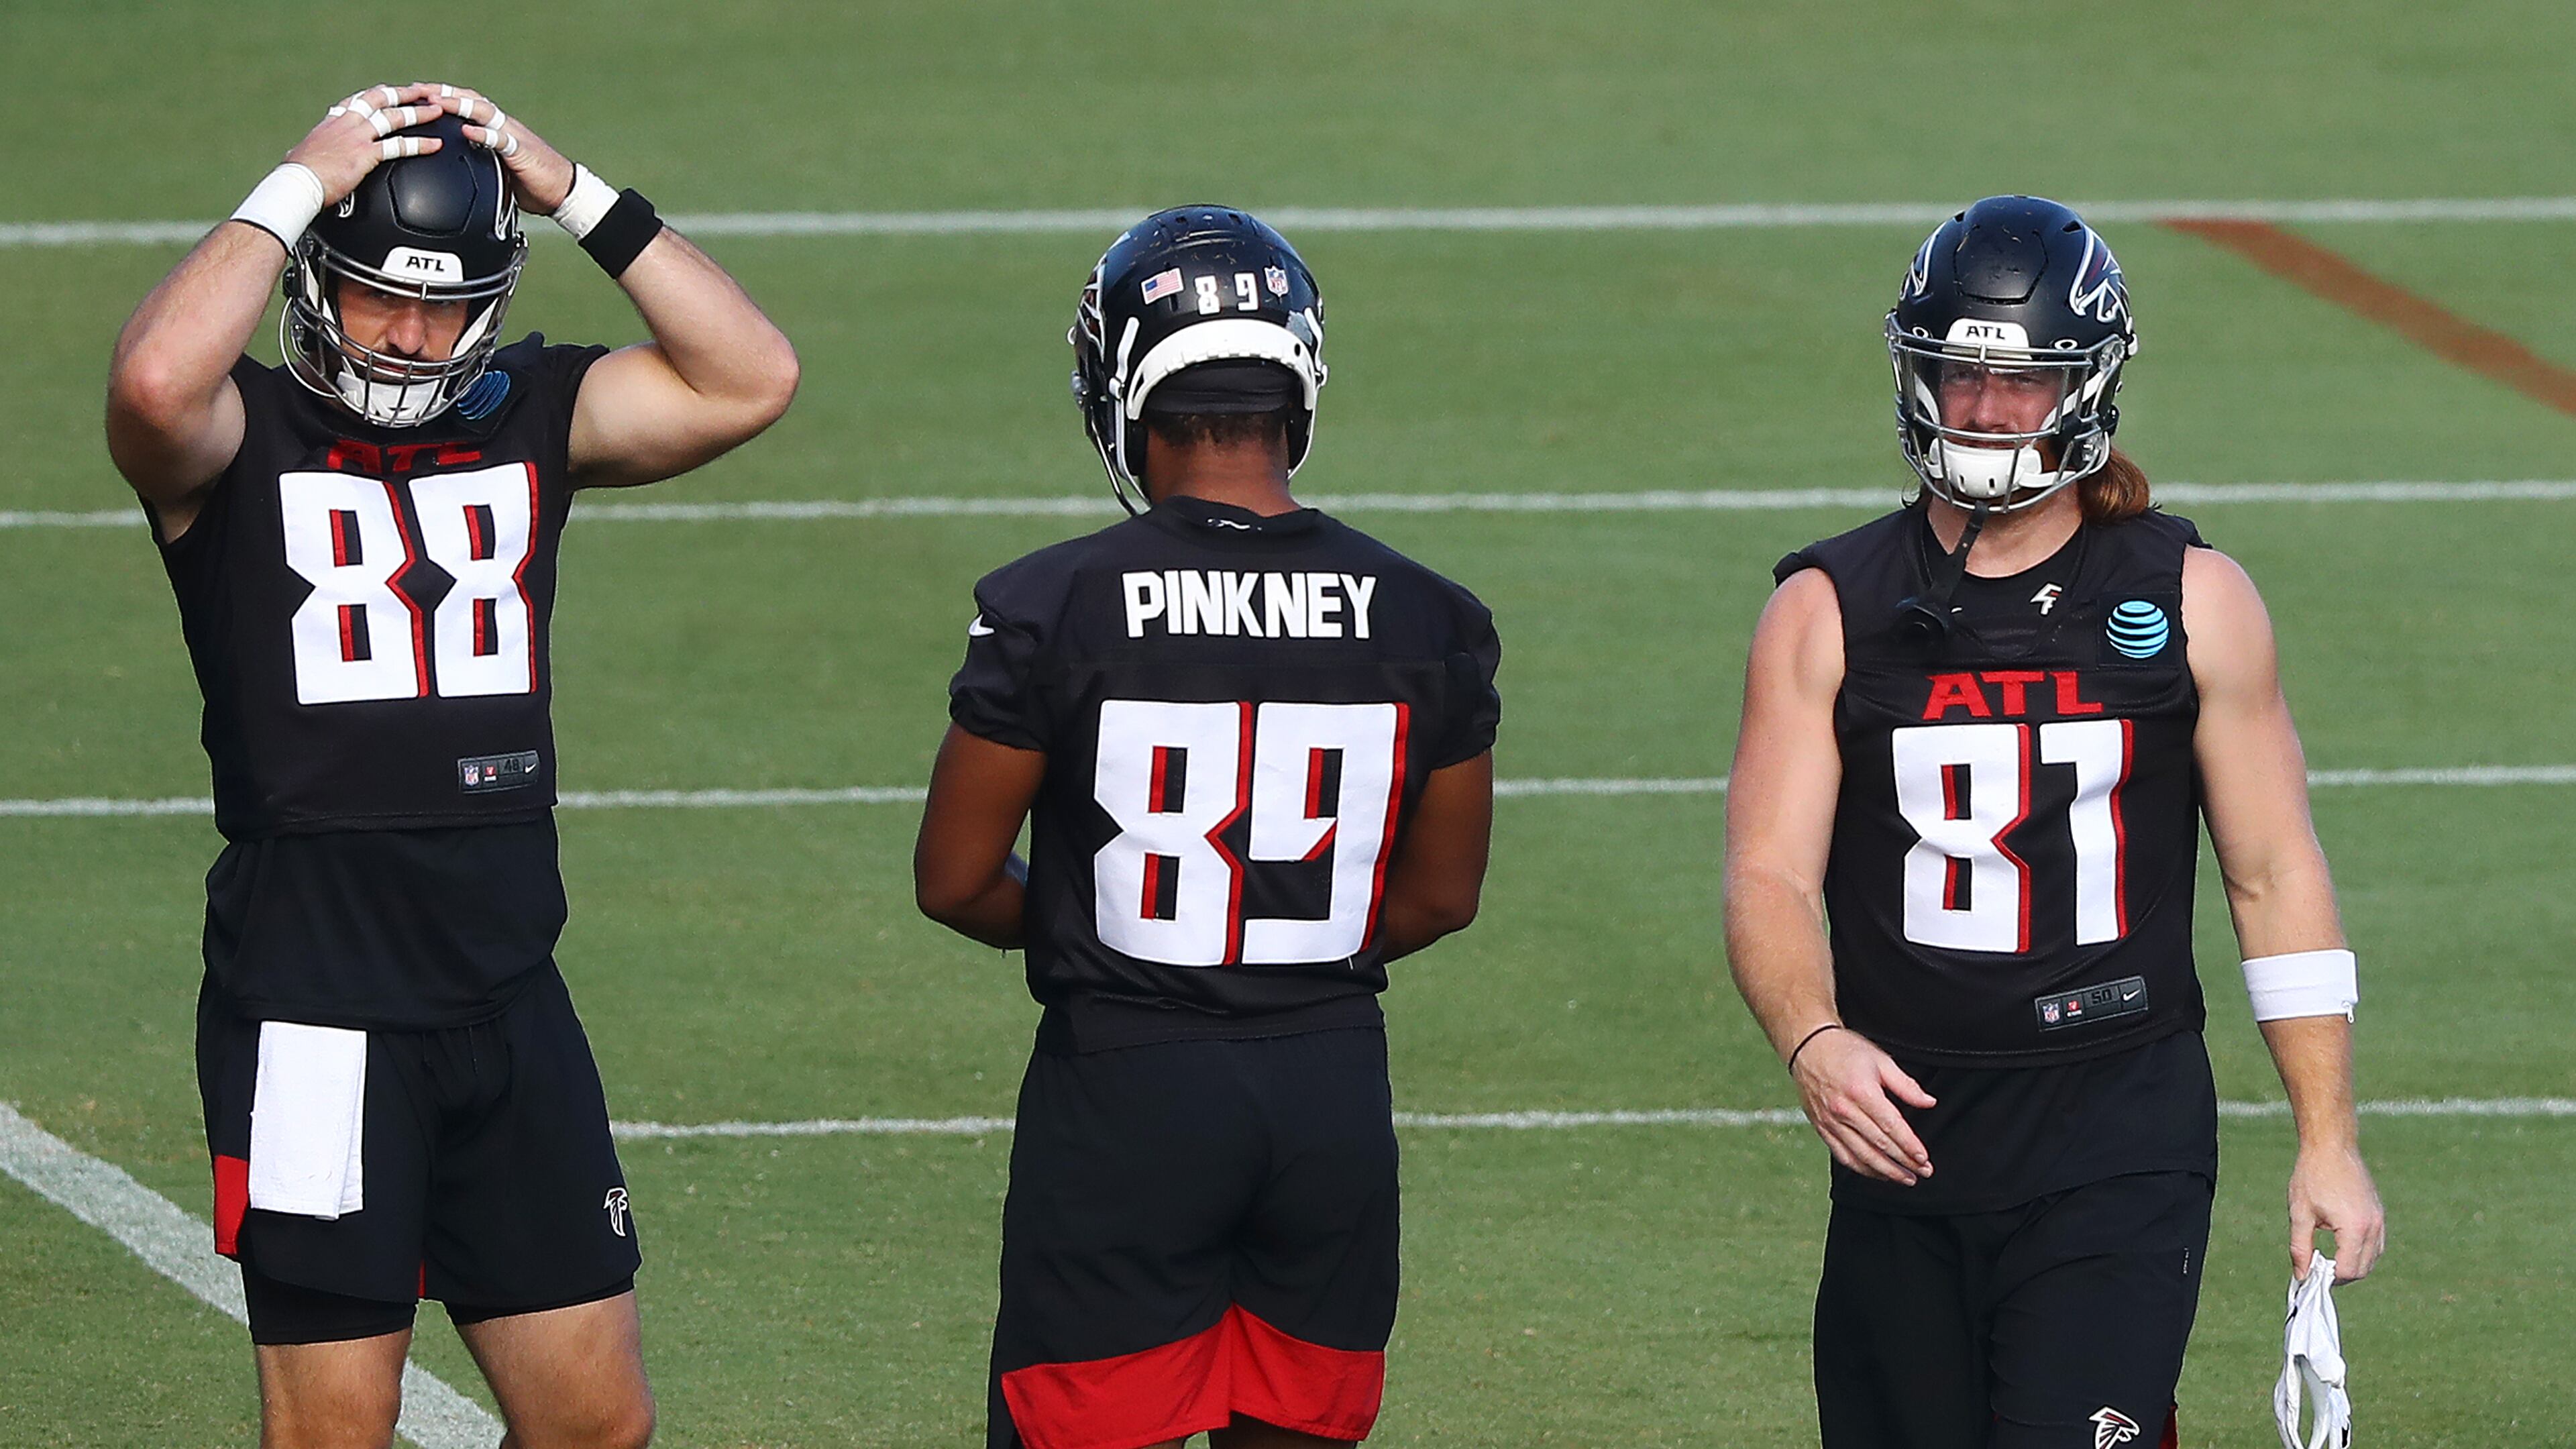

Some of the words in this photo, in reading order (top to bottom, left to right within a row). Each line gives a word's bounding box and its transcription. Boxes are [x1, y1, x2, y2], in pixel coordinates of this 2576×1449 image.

[405, 256, 445, 272] ATL
[1966, 325, 2005, 340] ATL
[278, 462, 538, 705] 88
[1122, 570, 1377, 639] PINKNEY
[1922, 671, 2104, 719] ATL
[1093, 700, 1410, 967] 89
[1892, 718, 2134, 953] 81
